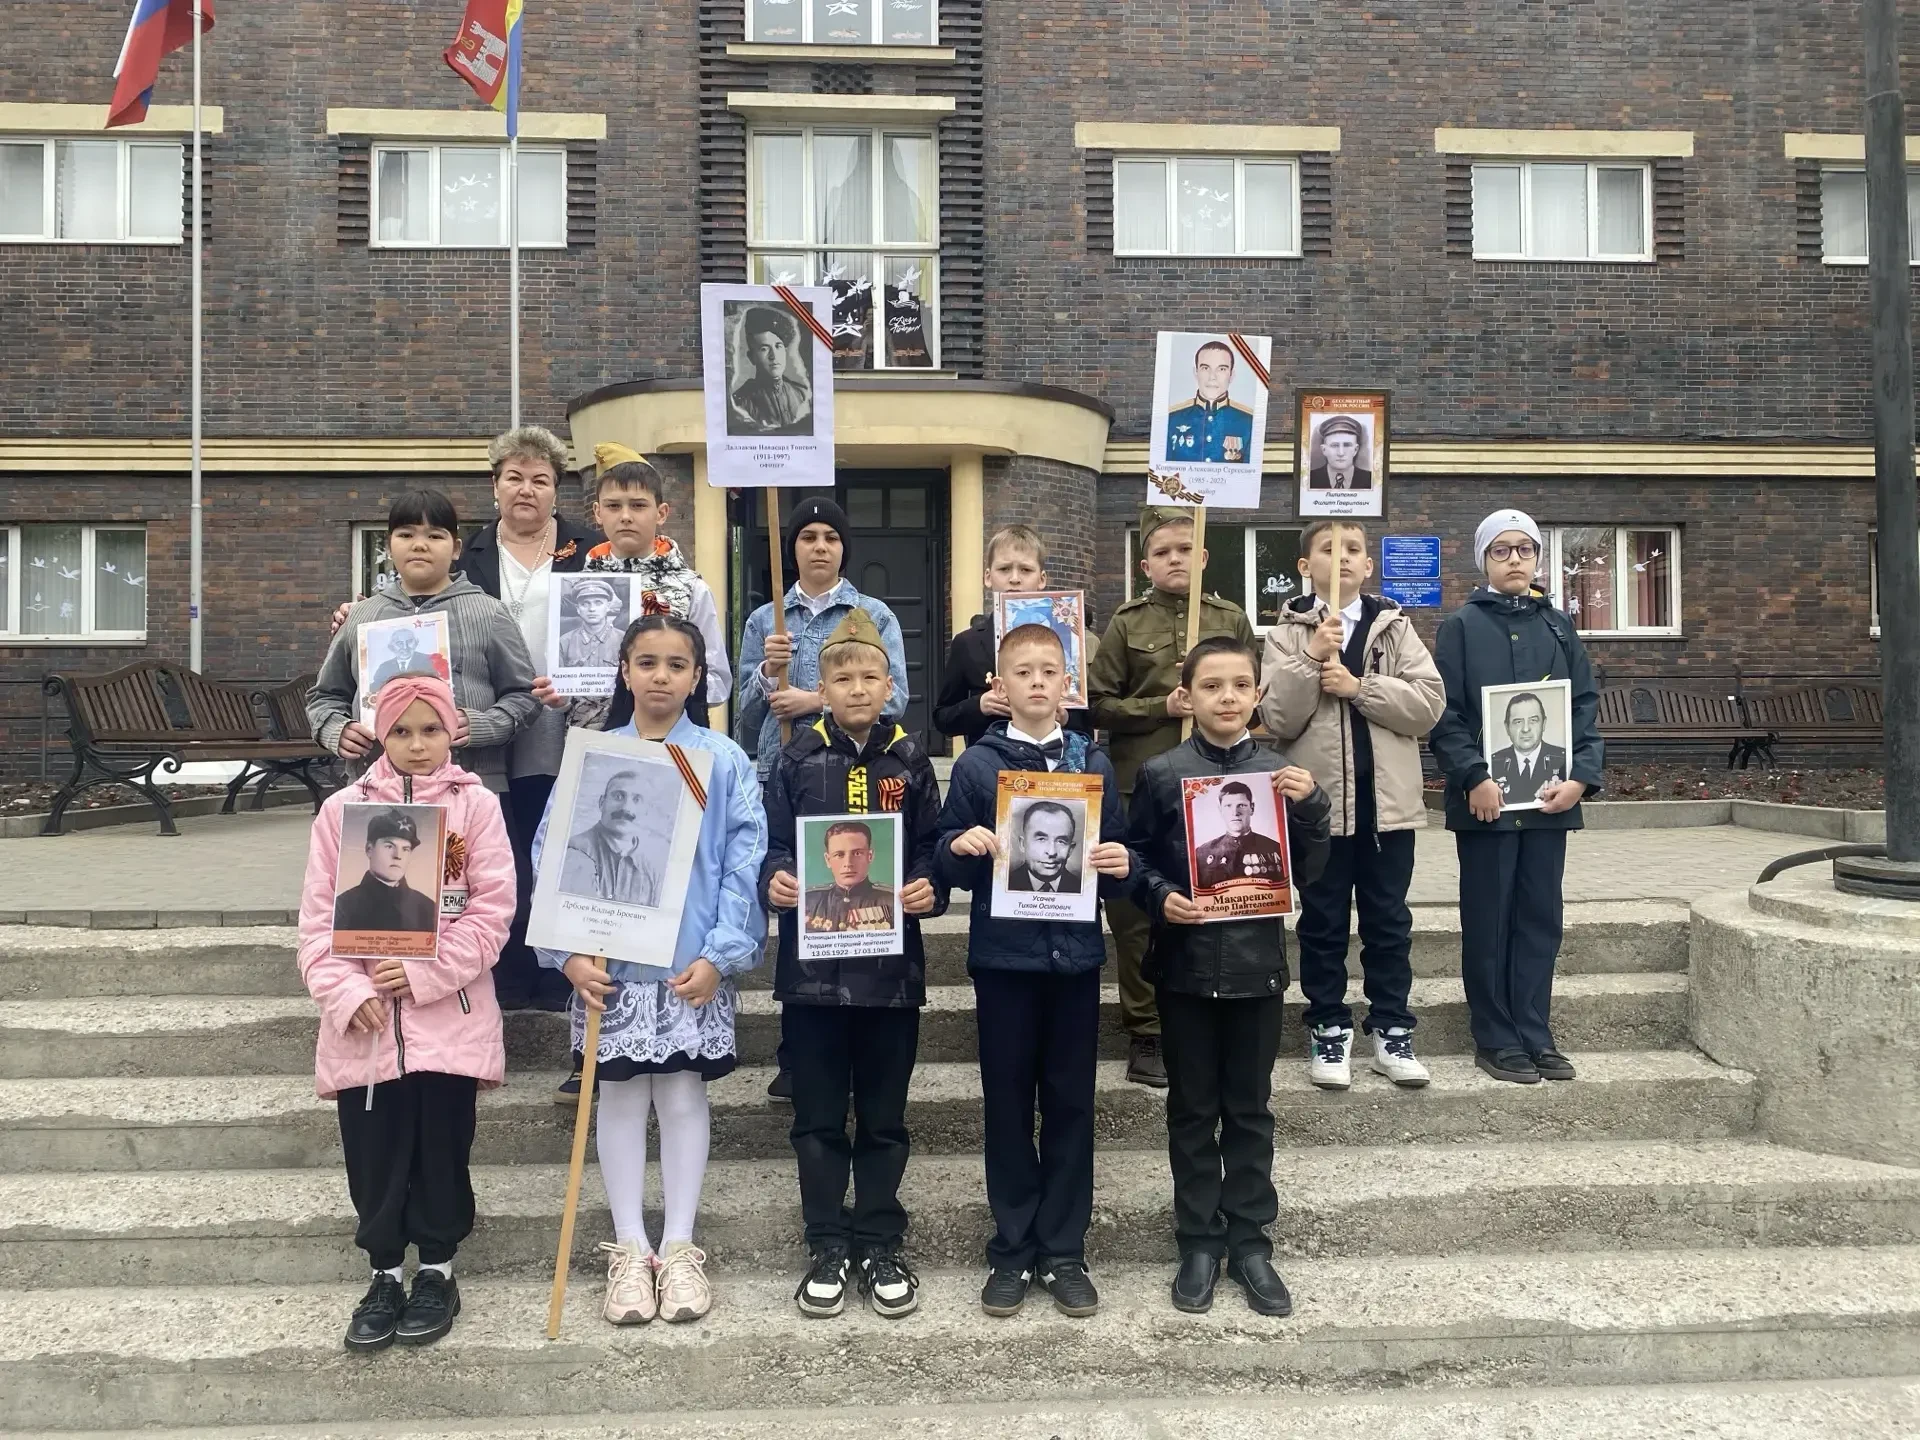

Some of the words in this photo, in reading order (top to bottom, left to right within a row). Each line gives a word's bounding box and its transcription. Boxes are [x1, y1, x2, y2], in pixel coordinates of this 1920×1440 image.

[1212, 892, 1274, 905] Макаренко
[1203, 904, 1230, 912] Фёдор
[1231, 900, 1286, 910] Пантелеевич
[1013, 909, 1044, 917] Старший
